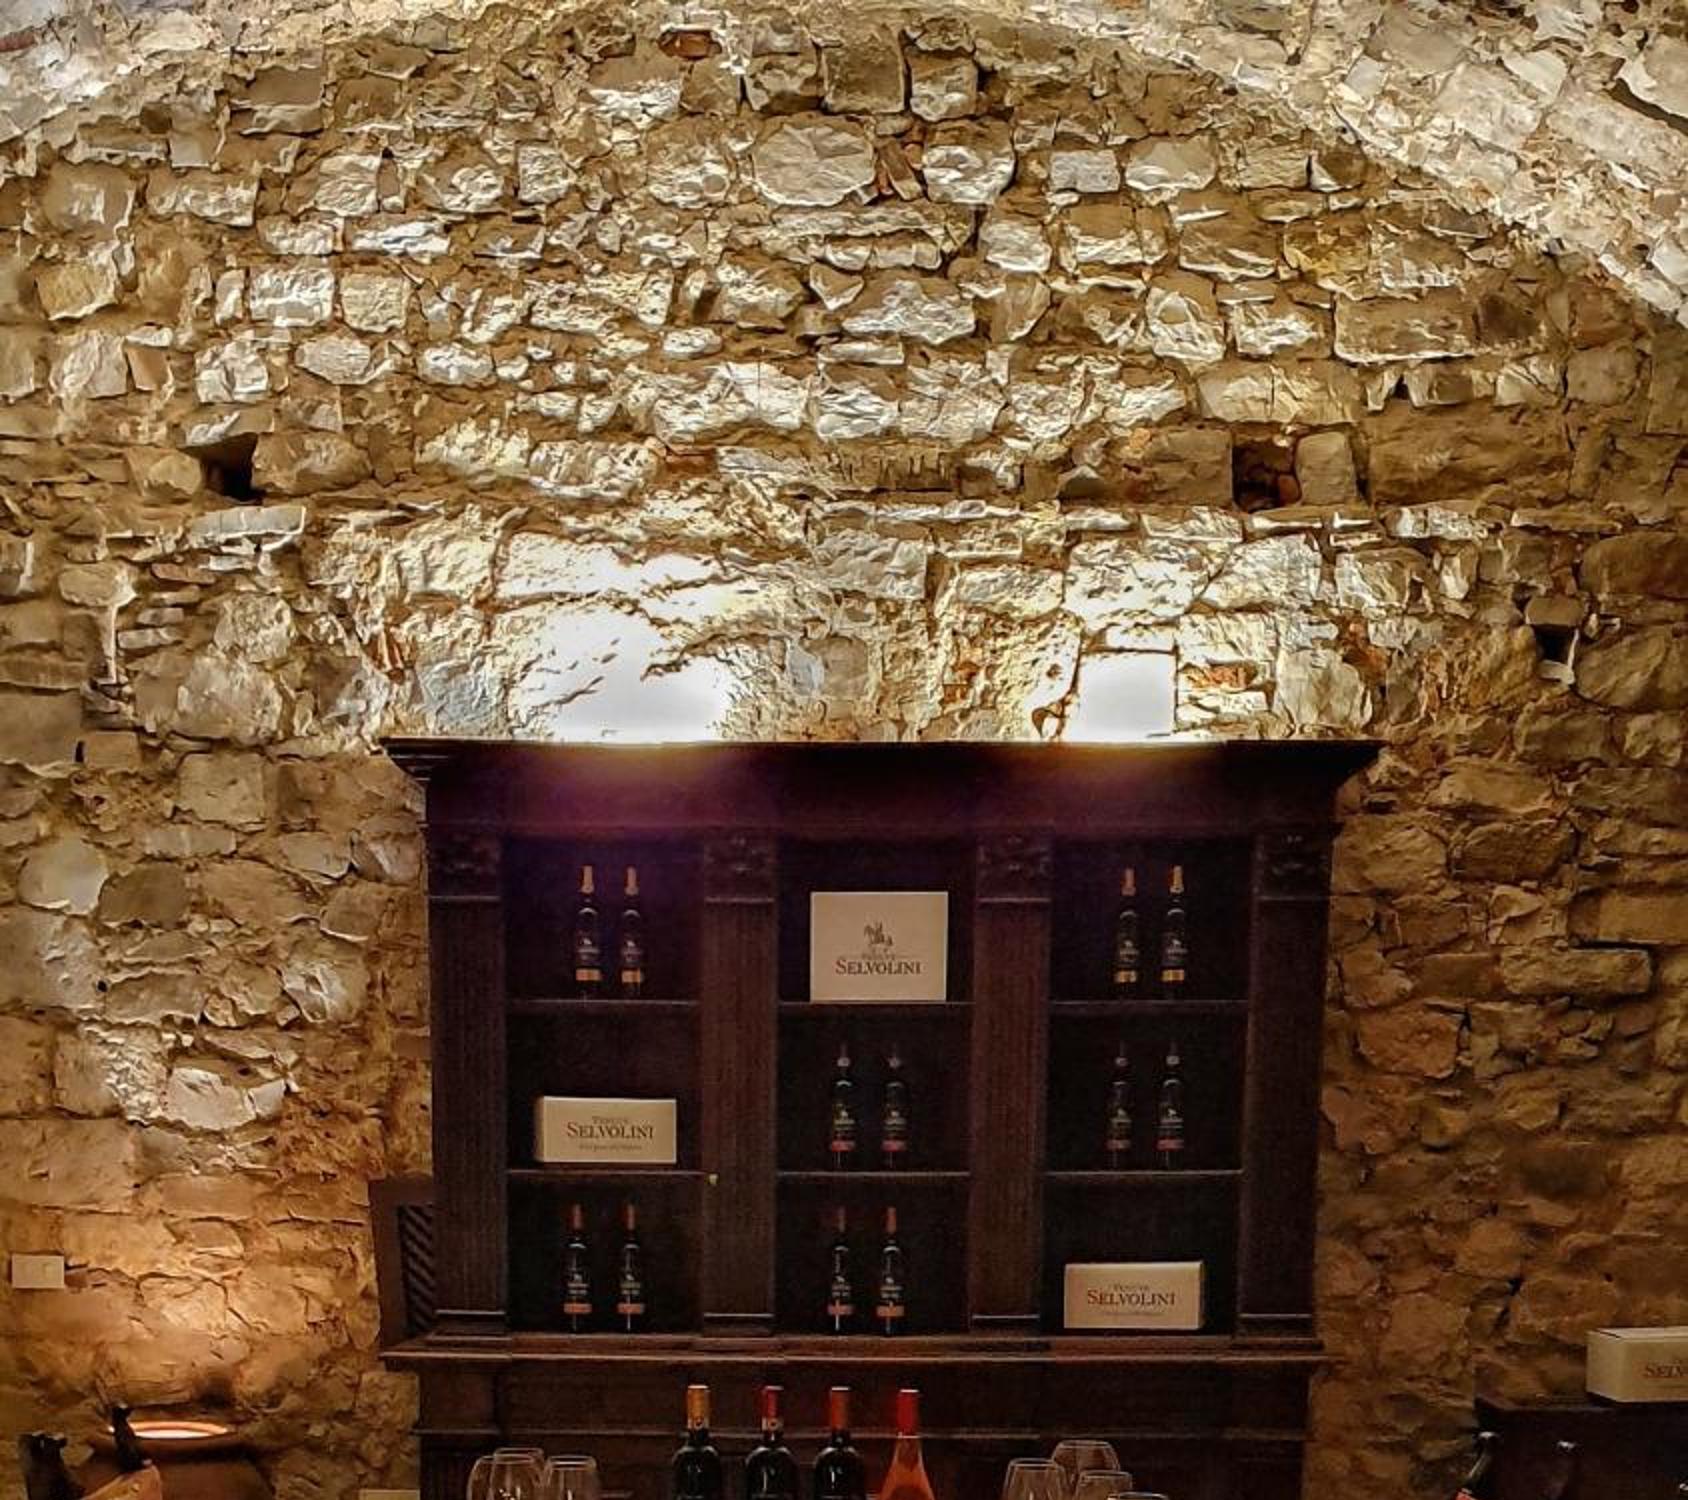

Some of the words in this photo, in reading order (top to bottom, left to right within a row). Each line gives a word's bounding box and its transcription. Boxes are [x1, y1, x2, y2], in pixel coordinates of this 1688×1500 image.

[835, 957, 921, 975] SELVOLINI
[567, 1121, 653, 1139] SELVOLINI
[1086, 1290, 1177, 1305] SELVOLINI
